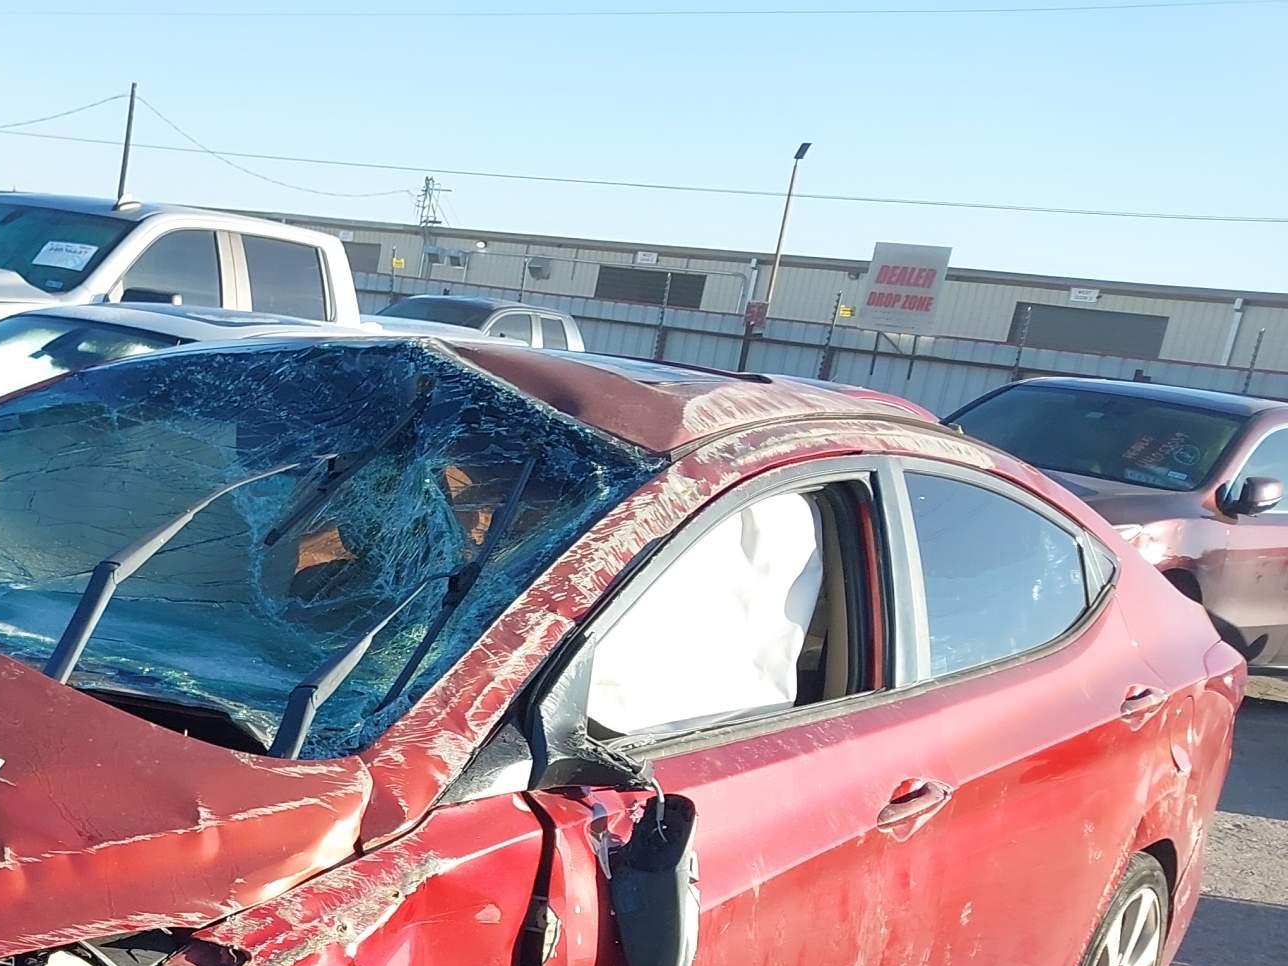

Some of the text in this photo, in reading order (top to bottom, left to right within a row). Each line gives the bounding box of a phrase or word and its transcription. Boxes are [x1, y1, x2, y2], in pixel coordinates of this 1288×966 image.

[875, 264, 937, 289] DEALER
[866, 291, 935, 312] DROP ZONE
